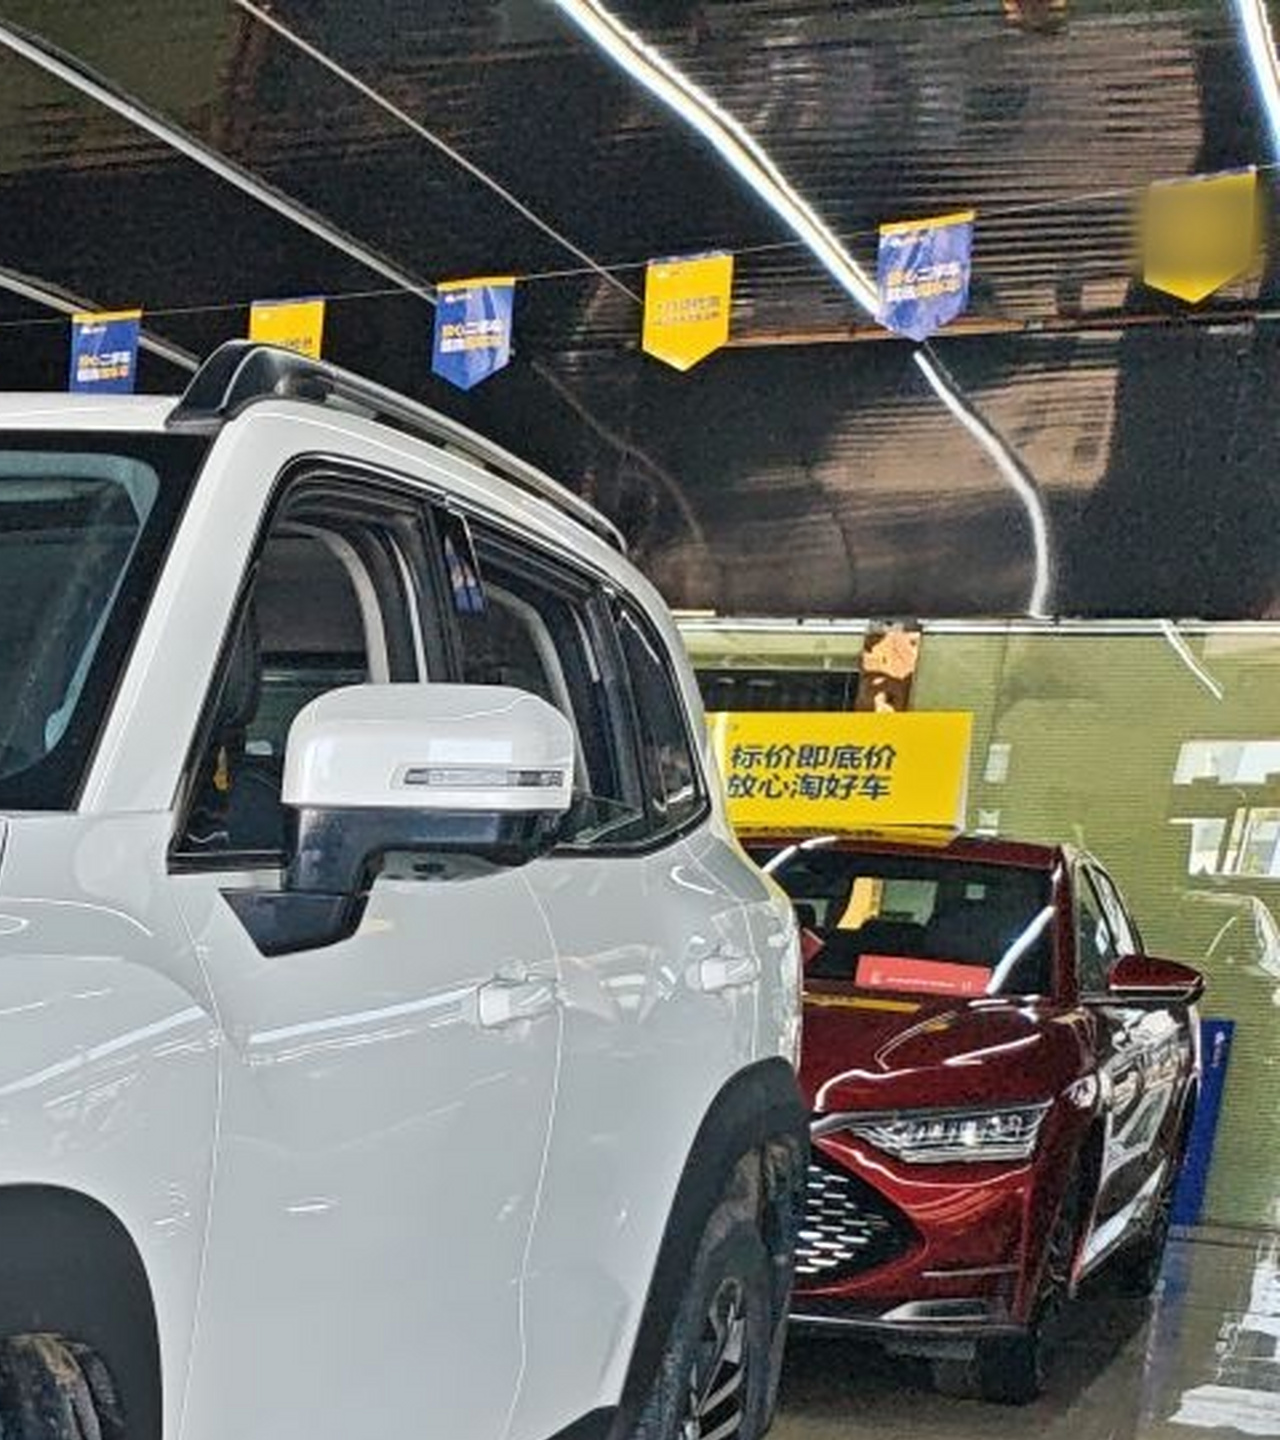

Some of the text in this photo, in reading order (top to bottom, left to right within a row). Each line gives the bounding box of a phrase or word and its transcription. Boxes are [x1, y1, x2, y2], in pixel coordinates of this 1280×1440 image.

[732, 744, 897, 770] 标价即底价
[728, 773, 891, 800] 放心淘好车
